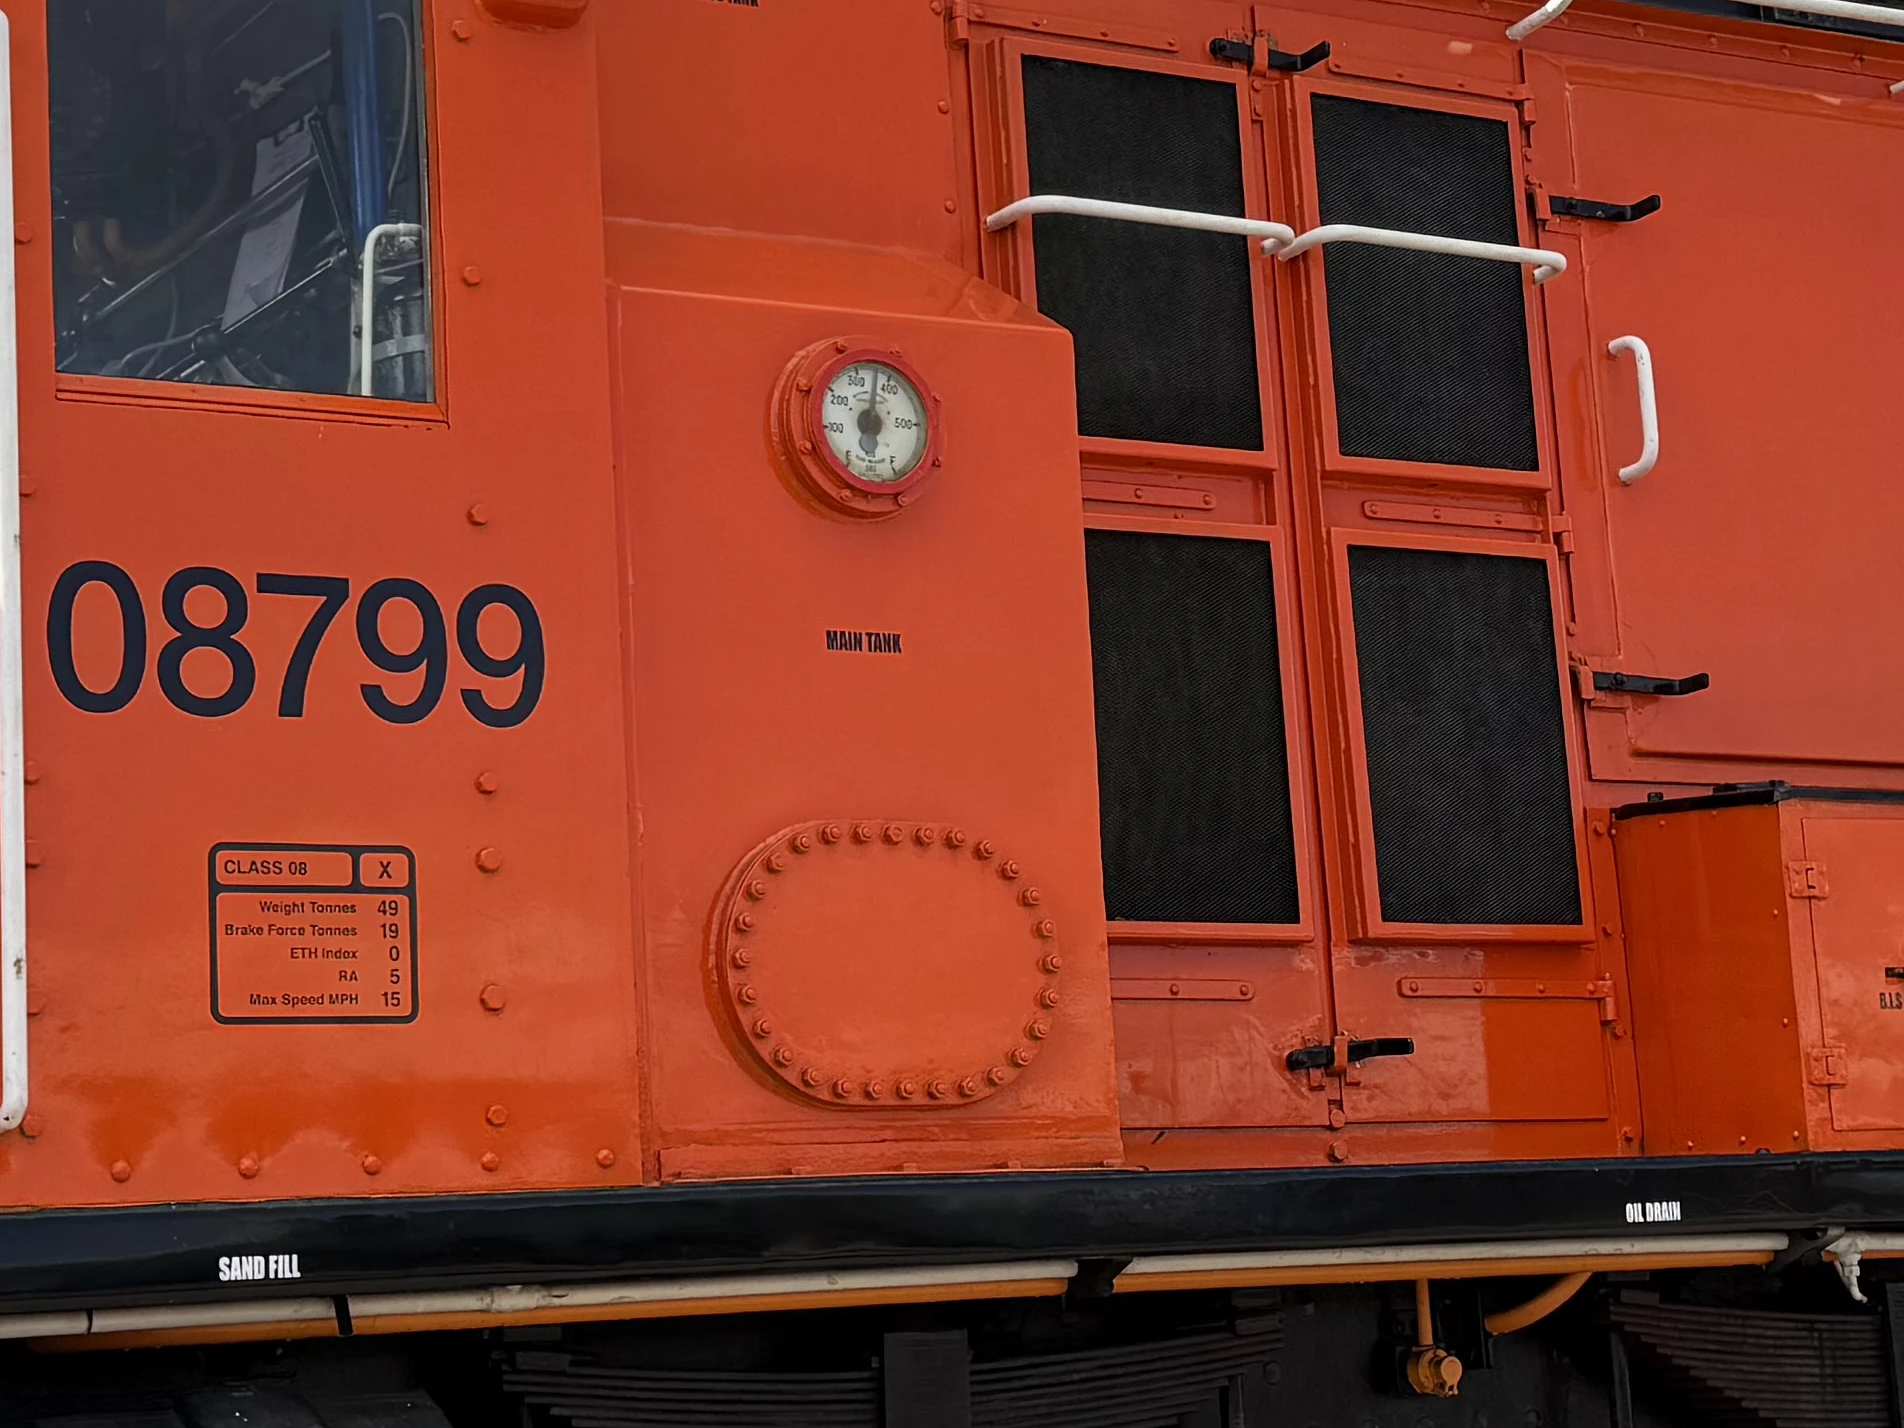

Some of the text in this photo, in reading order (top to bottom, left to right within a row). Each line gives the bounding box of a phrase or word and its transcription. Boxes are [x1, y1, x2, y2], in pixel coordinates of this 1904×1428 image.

[881, 383, 898, 395] 400
[831, 394, 848, 406] 200
[895, 417, 912, 430] 500
[46, 560, 545, 728] 08799
[826, 630, 902, 653] MAIN TANK
[224, 860, 308, 876] CLASS 08
[378, 861, 392, 879] X
[259, 900, 399, 916] Weight Tonnes 49
[225, 923, 399, 939] Brake Force Tonnes 19
[291, 946, 400, 962] ETH Index 0
[339, 969, 400, 984] RA 5
[250, 991, 401, 1008] Max Speed MPH 15
[1625, 1201, 1681, 1223] OIL DRAIN
[218, 1254, 302, 1281] SAND FILL
